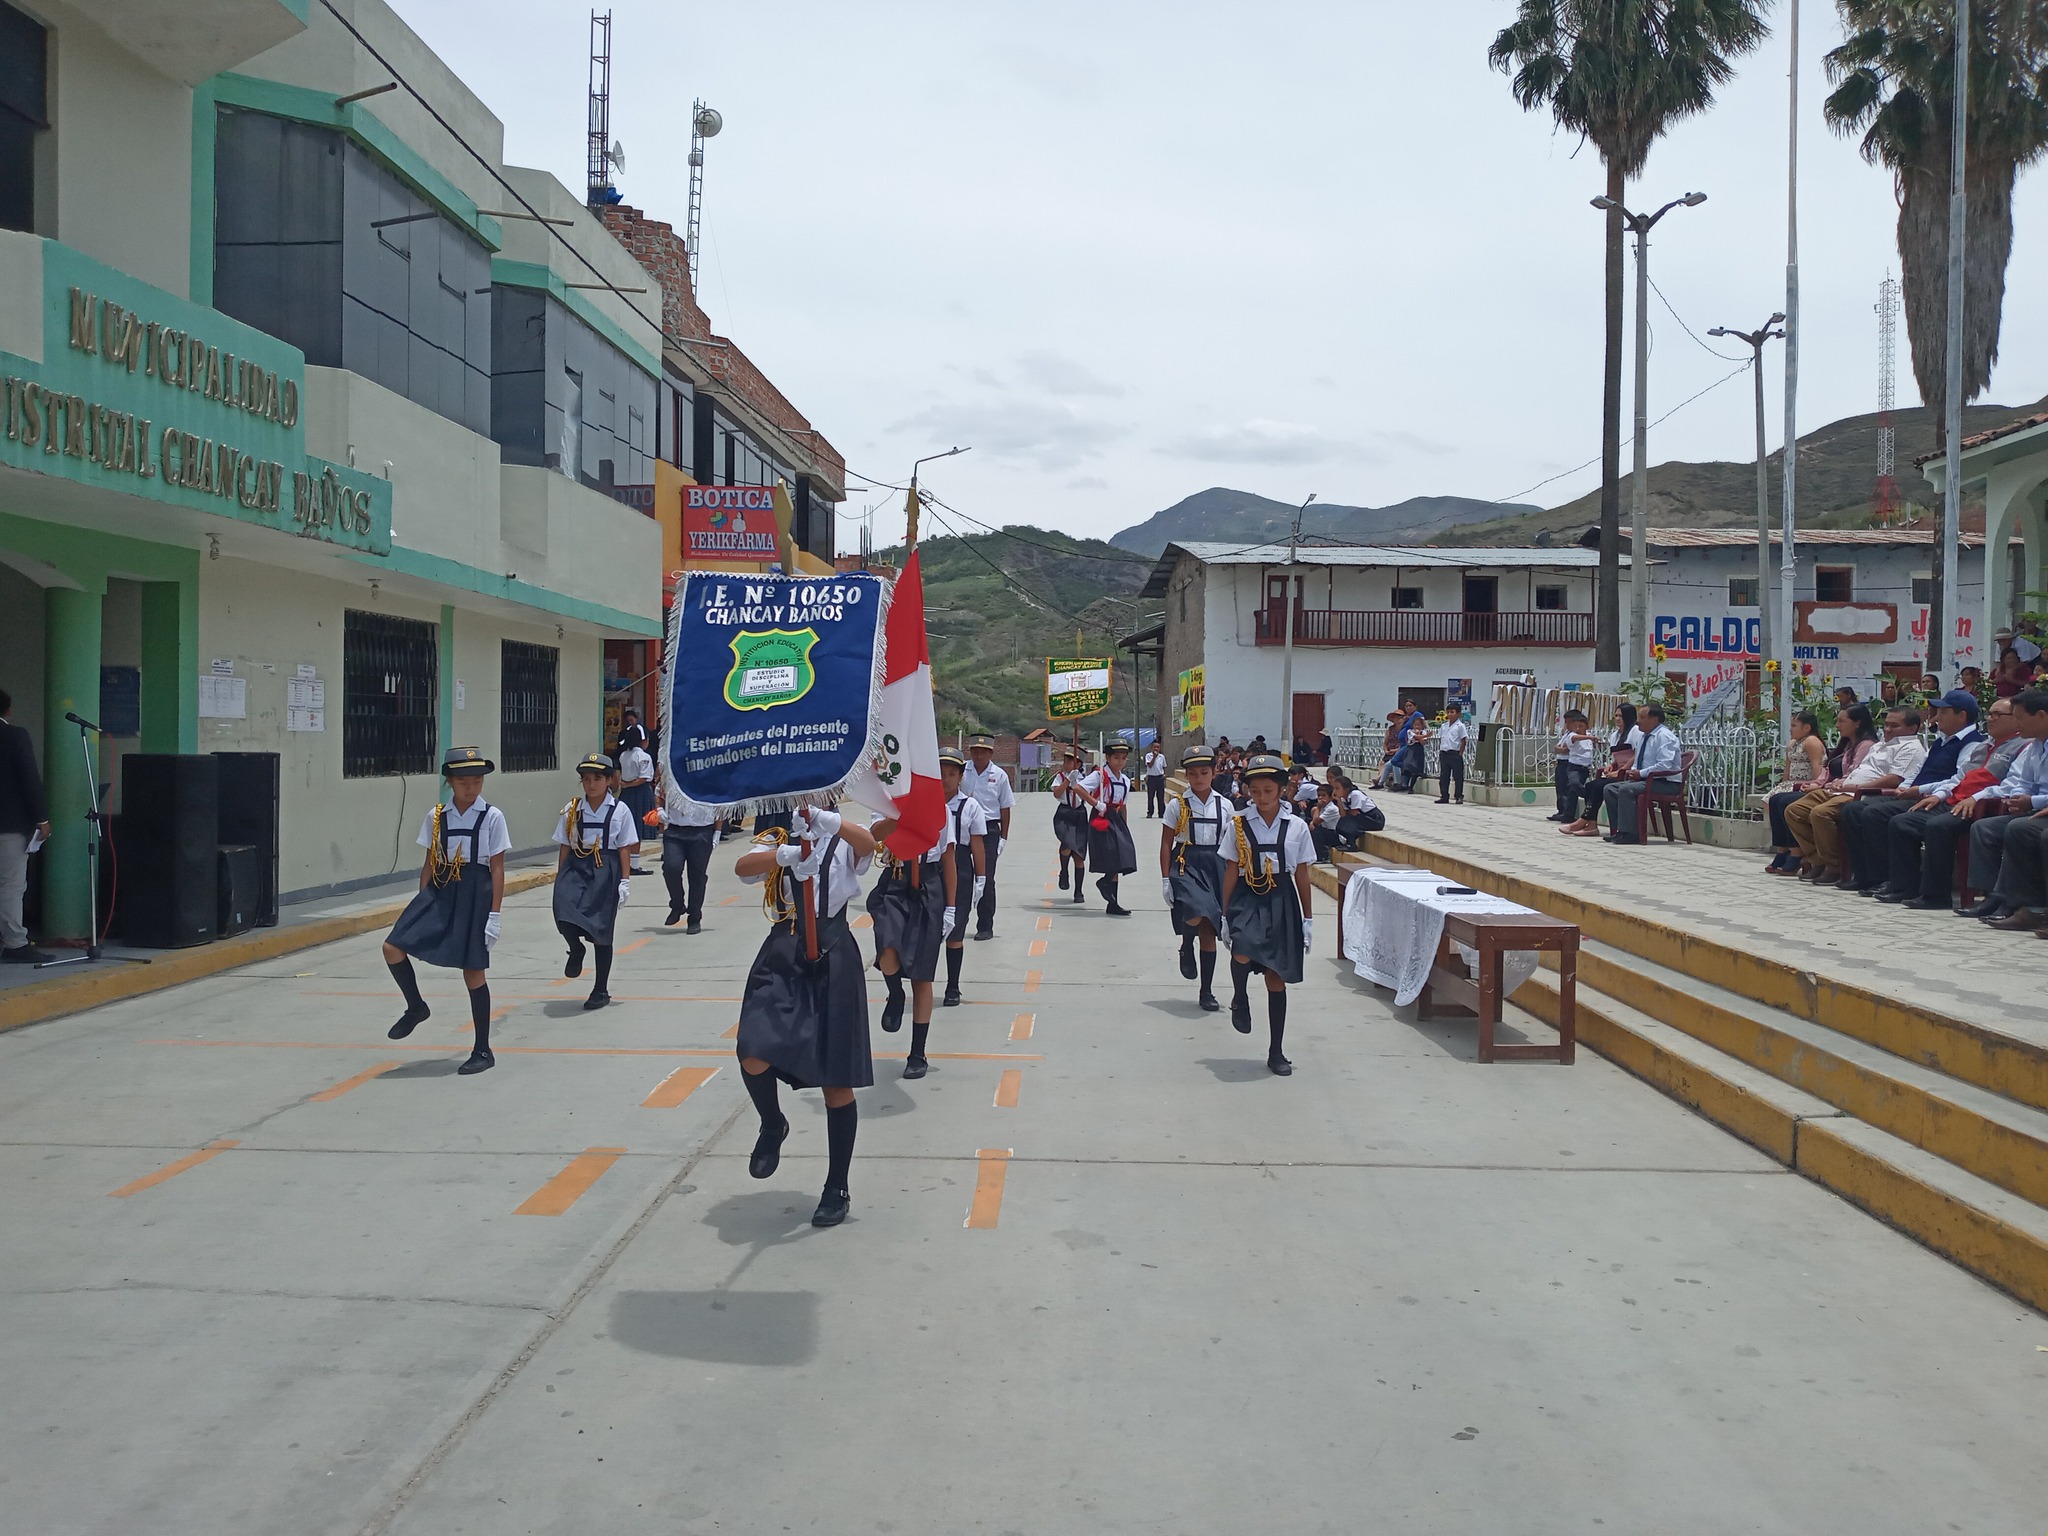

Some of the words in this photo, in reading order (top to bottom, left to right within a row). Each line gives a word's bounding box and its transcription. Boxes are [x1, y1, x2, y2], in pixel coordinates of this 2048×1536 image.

[71, 286, 299, 428] MUNICIPALIDAD
[162, 427, 284, 512] CHANCAY
[293, 466, 371, 535] BAÑOS
[688, 489, 773, 509] BOTICA
[689, 531, 775, 551] YERIKFARMA
[789, 585, 862, 606] 10650
[705, 606, 784, 625] CHANCAY
[788, 605, 843, 623] BAÑOS
[765, 658, 789, 667] 10650
[1793, 646, 1839, 659] WALTER
[743, 695, 771, 704] CHANCAY
[772, 693, 791, 701] BAÑOS
[767, 724, 787, 739] del
[790, 719, 849, 739] presente
[685, 744, 758, 773] innovadores
[761, 740, 781, 756] del
